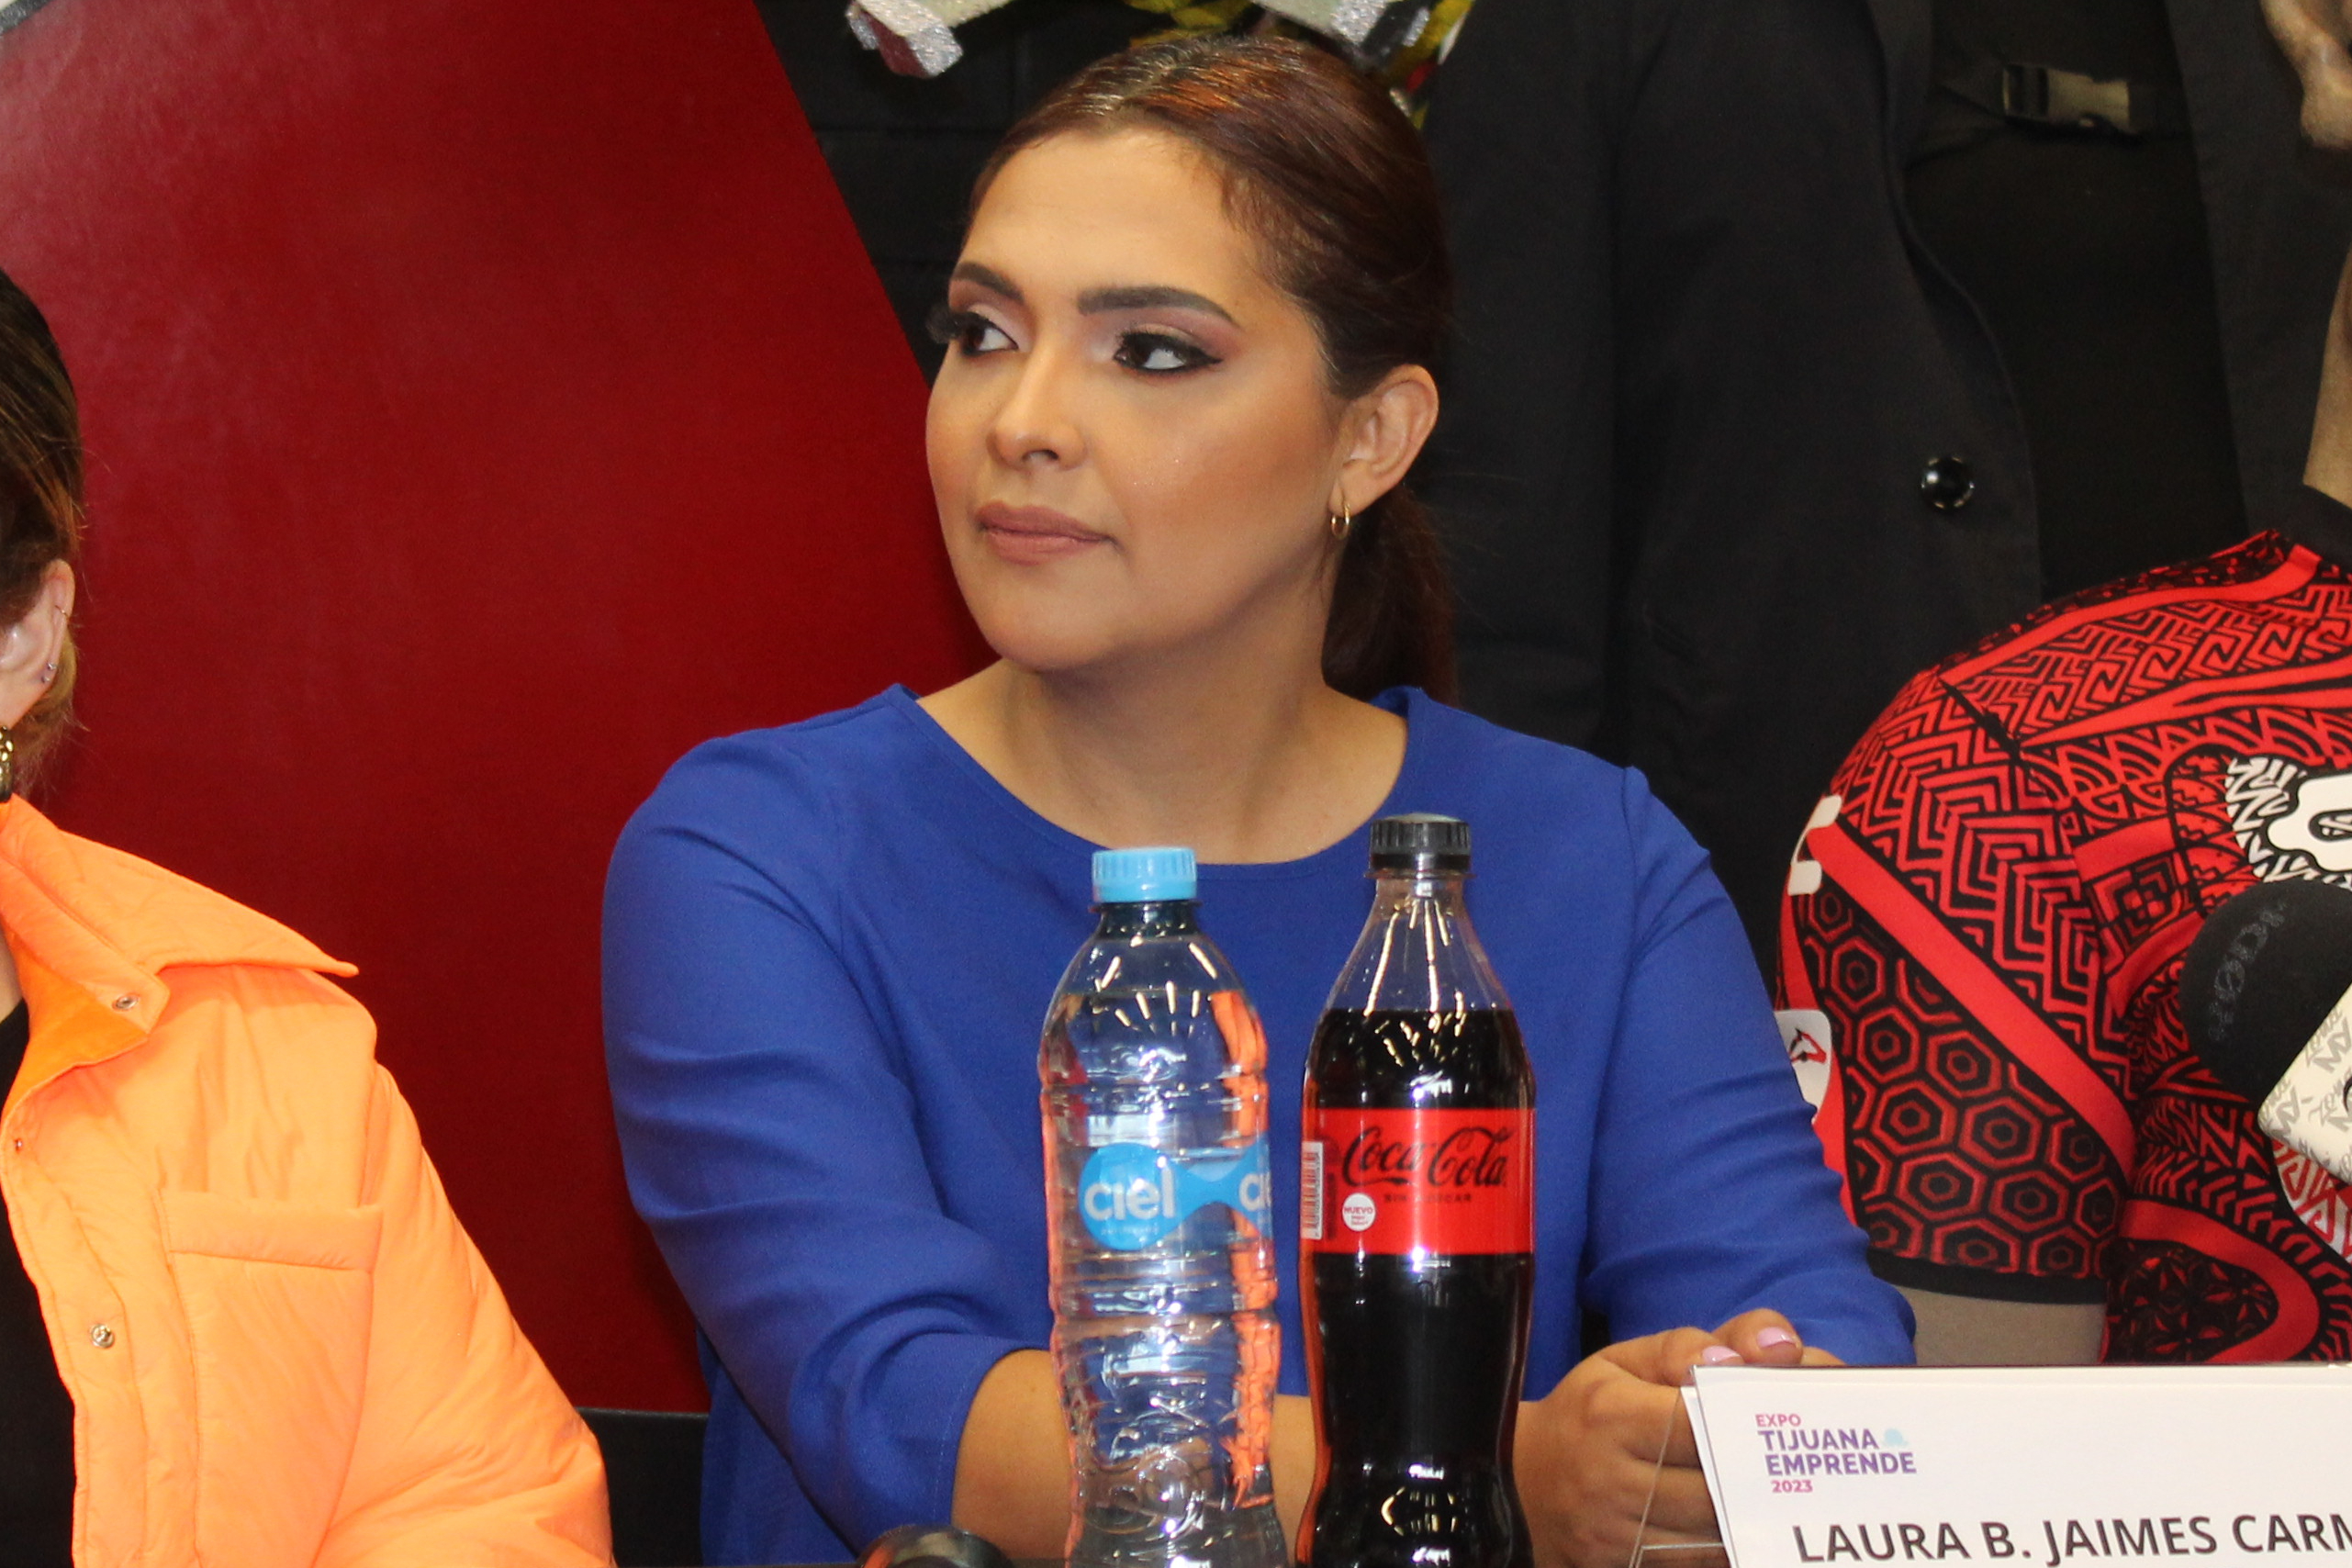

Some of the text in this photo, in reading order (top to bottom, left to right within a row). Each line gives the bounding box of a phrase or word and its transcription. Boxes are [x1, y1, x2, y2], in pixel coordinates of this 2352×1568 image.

[1084, 1164, 1176, 1221] ciel
[1755, 1414, 1801, 1428] EXPO
[1758, 1428, 1879, 1451] TIJUANA
[1764, 1452, 1917, 1476] EMPRENDE
[1771, 1479, 1813, 1494] 2023
[1792, 1522, 1972, 1562] LAURA
[1980, 1521, 2032, 1559] B.
[2043, 1516, 2218, 1567] JAIMES
